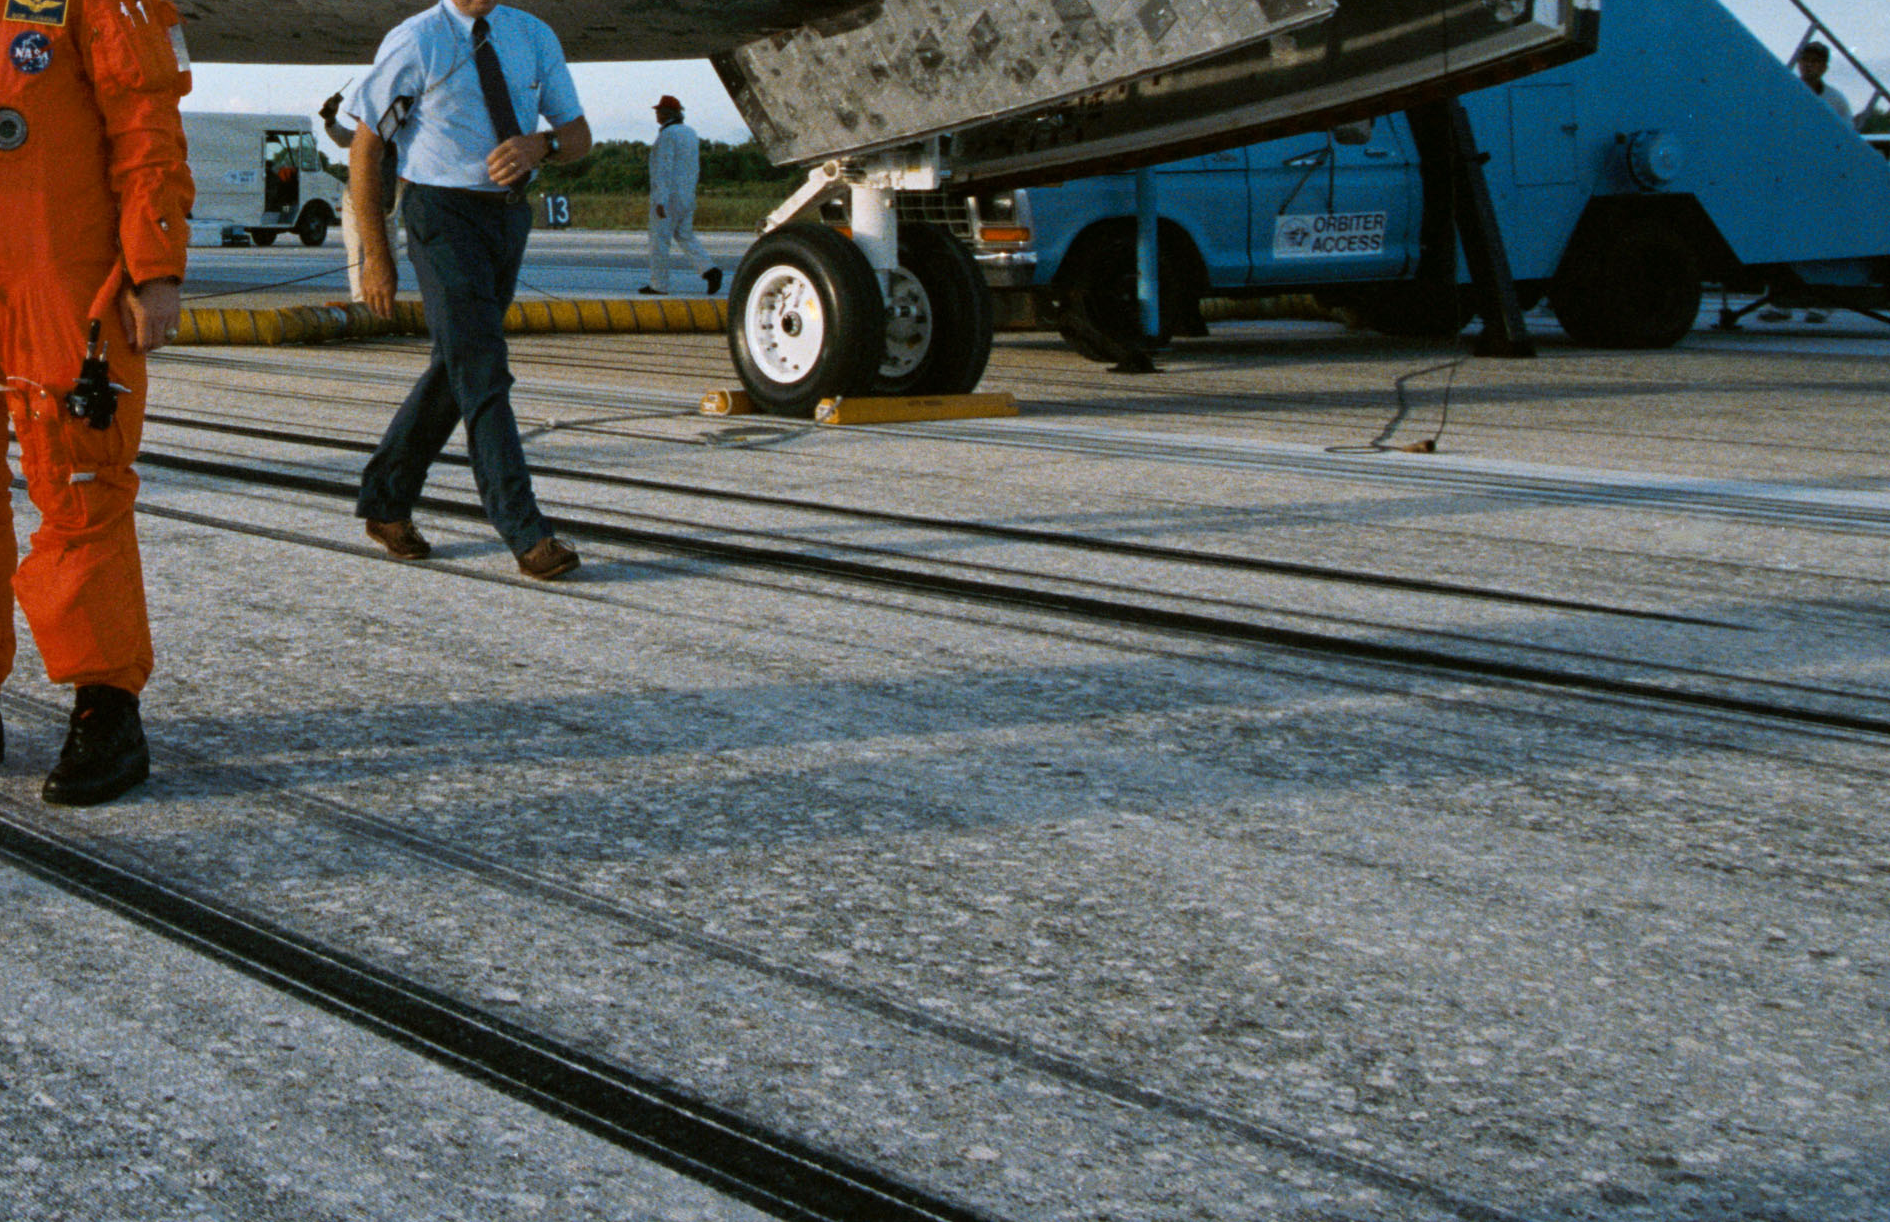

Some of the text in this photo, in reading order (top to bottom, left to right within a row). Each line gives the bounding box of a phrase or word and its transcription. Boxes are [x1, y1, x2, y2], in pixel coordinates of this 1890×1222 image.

[14, 46, 49, 60] NASA
[546, 195, 570, 224] 13
[1313, 214, 1385, 233] ORBITER
[1311, 234, 1382, 253] ACCESS
